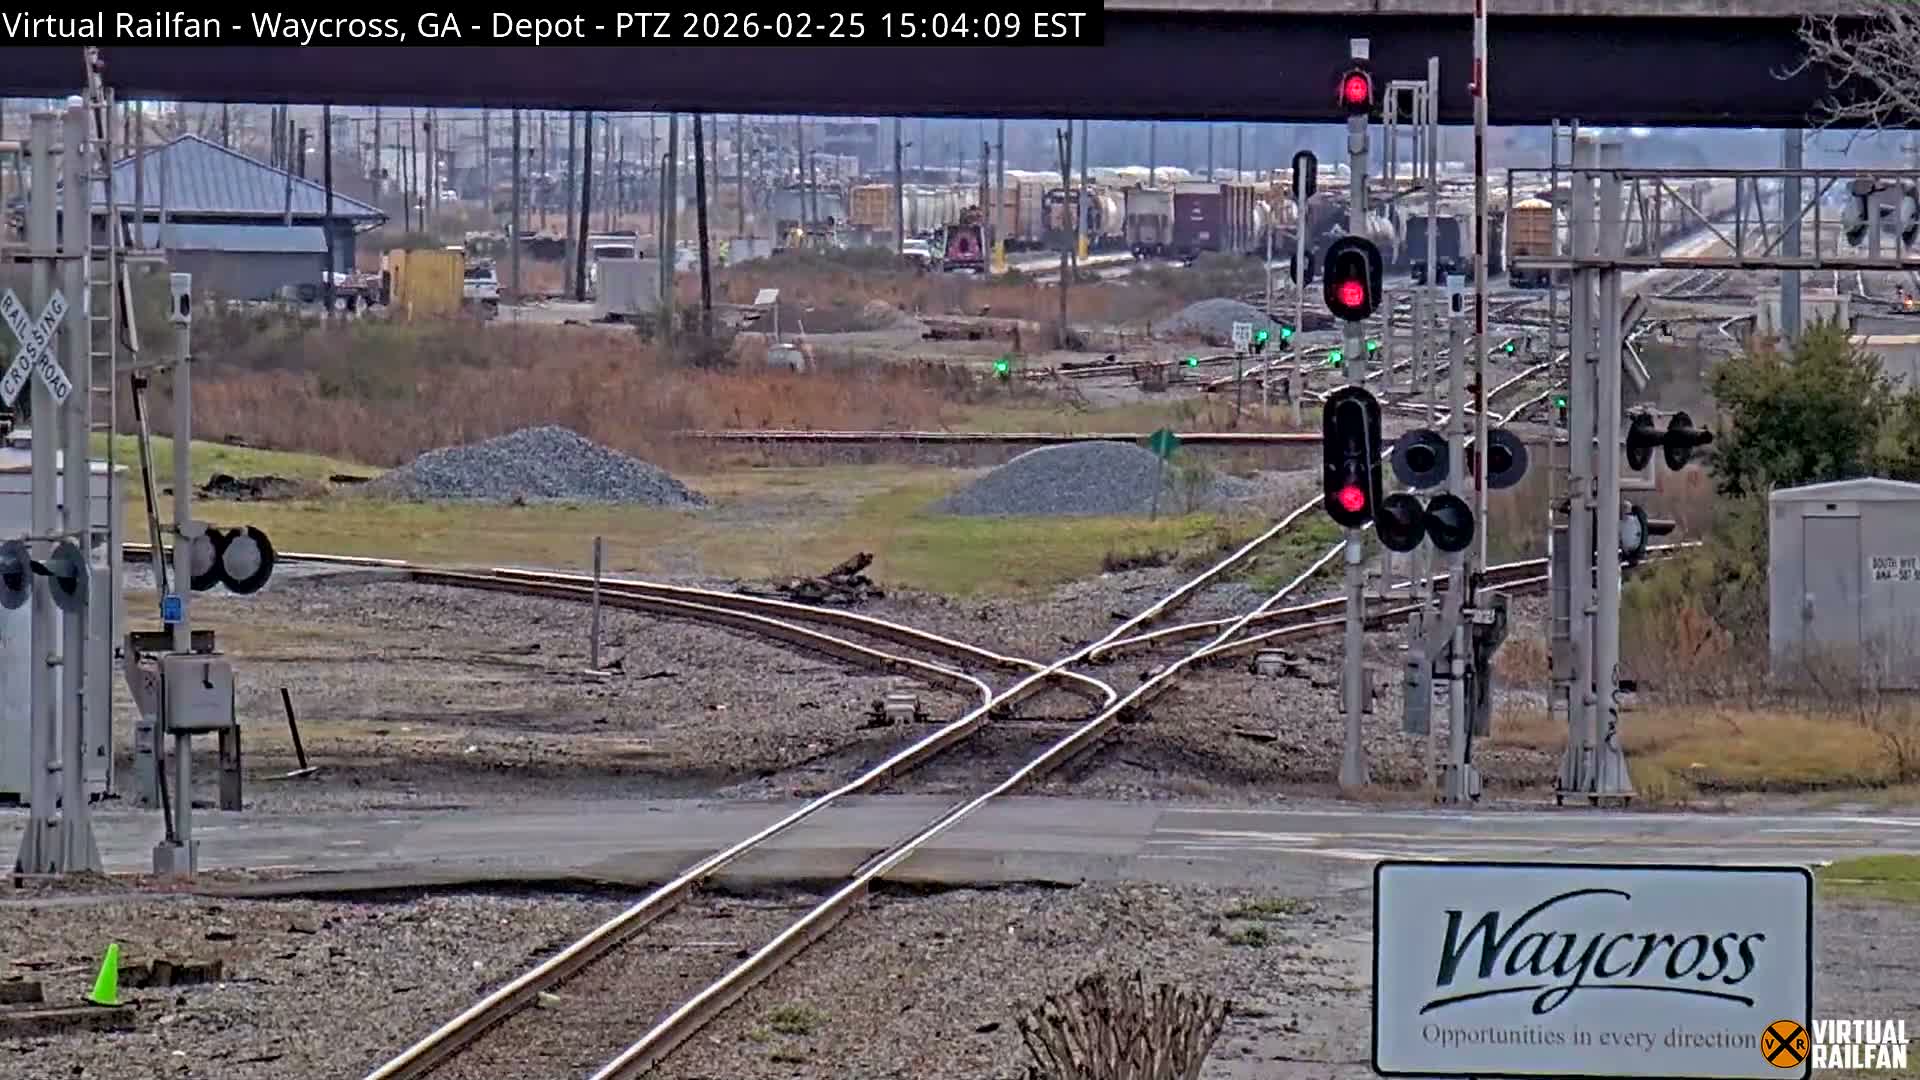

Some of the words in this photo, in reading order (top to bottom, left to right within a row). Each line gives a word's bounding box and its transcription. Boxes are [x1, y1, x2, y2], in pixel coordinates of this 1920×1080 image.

[3, 296, 27, 340] RAIL
[40, 354, 67, 398] ROAD
[4, 299, 63, 395] CROSSING
[1436, 889, 1766, 1015] Waycross
[1421, 1023, 1566, 1048] Opportunities
[1573, 1024, 1592, 1046] in
[1599, 1030, 1658, 1053] every
[1663, 1027, 1757, 1049] direction
